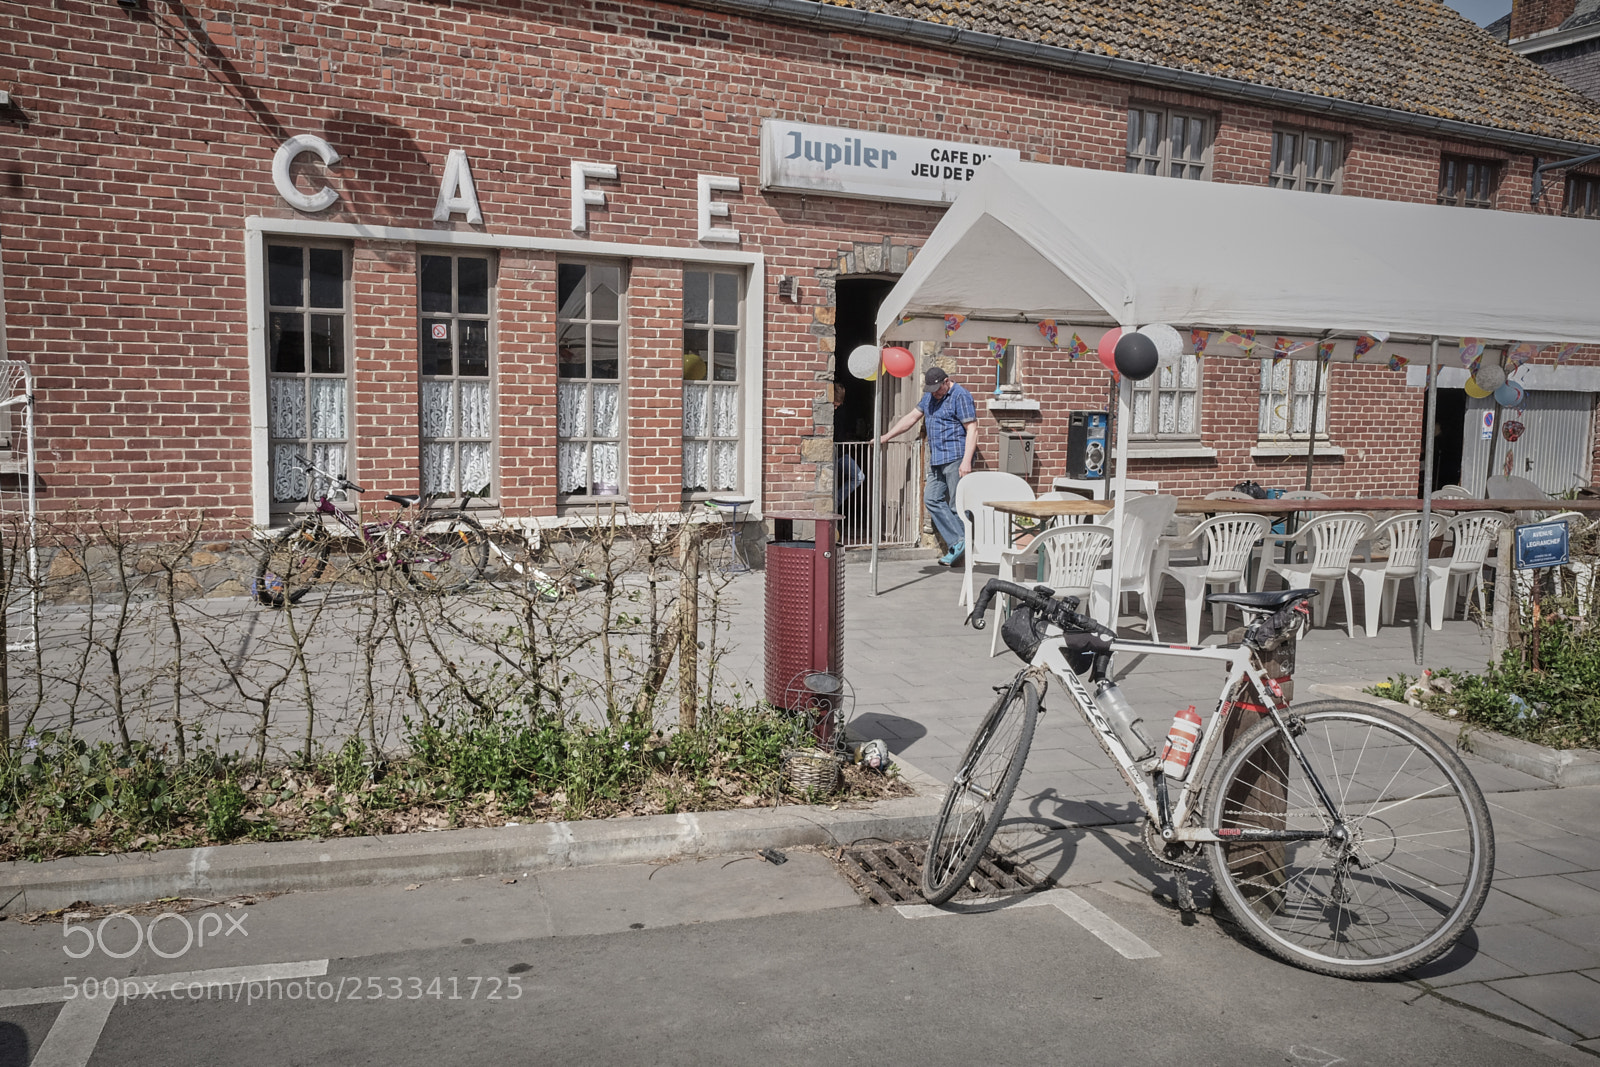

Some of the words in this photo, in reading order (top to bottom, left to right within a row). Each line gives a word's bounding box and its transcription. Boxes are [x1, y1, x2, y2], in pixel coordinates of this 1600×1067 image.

[785, 131, 898, 171] Jupiler
[930, 148, 968, 165] CAFE
[911, 163, 940, 179] JEU
[943, 167, 963, 181] DE
[272, 134, 741, 243] CAFE
[1025, 441, 1031, 453] 8
[1532, 530, 1553, 538] AVENUE
[1062, 668, 1119, 742] RIDLEY
